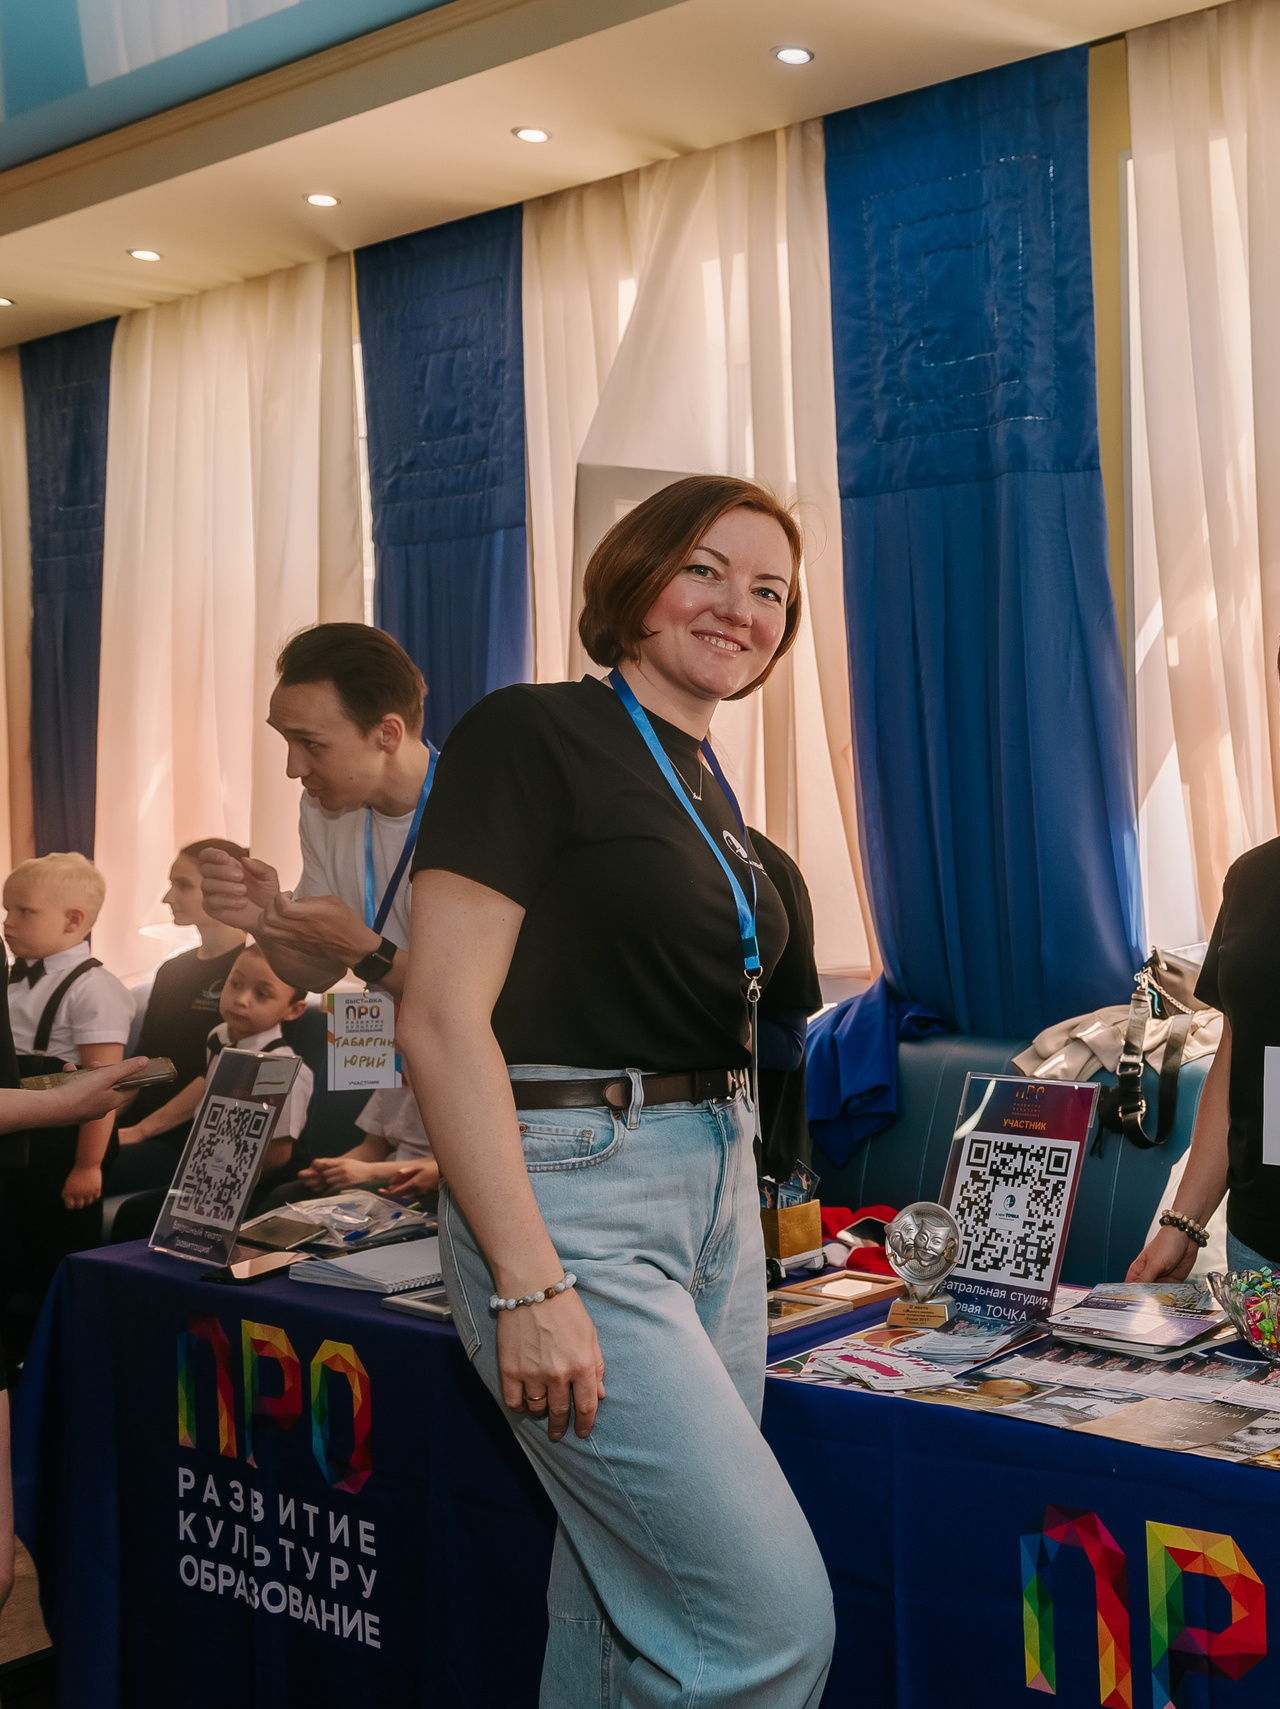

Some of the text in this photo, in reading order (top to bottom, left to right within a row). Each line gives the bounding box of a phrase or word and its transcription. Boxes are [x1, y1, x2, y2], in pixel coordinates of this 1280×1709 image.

[345, 1005, 380, 1020] ПРО
[343, 1053, 387, 1068] ЮРИЙ
[1003, 1118, 1047, 1130] УЧАСТНИК
[941, 1280, 1006, 1299] еатральная
[955, 1302, 1027, 1321] овая ТОЧКА
[176, 1314, 373, 1495] ПРО
[178, 1466, 376, 1556] РАЗВИТИЕ
[178, 1510, 377, 1600] КУЛЬТУРУ
[179, 1554, 381, 1649] ОБРАЗОВАНИЕ
